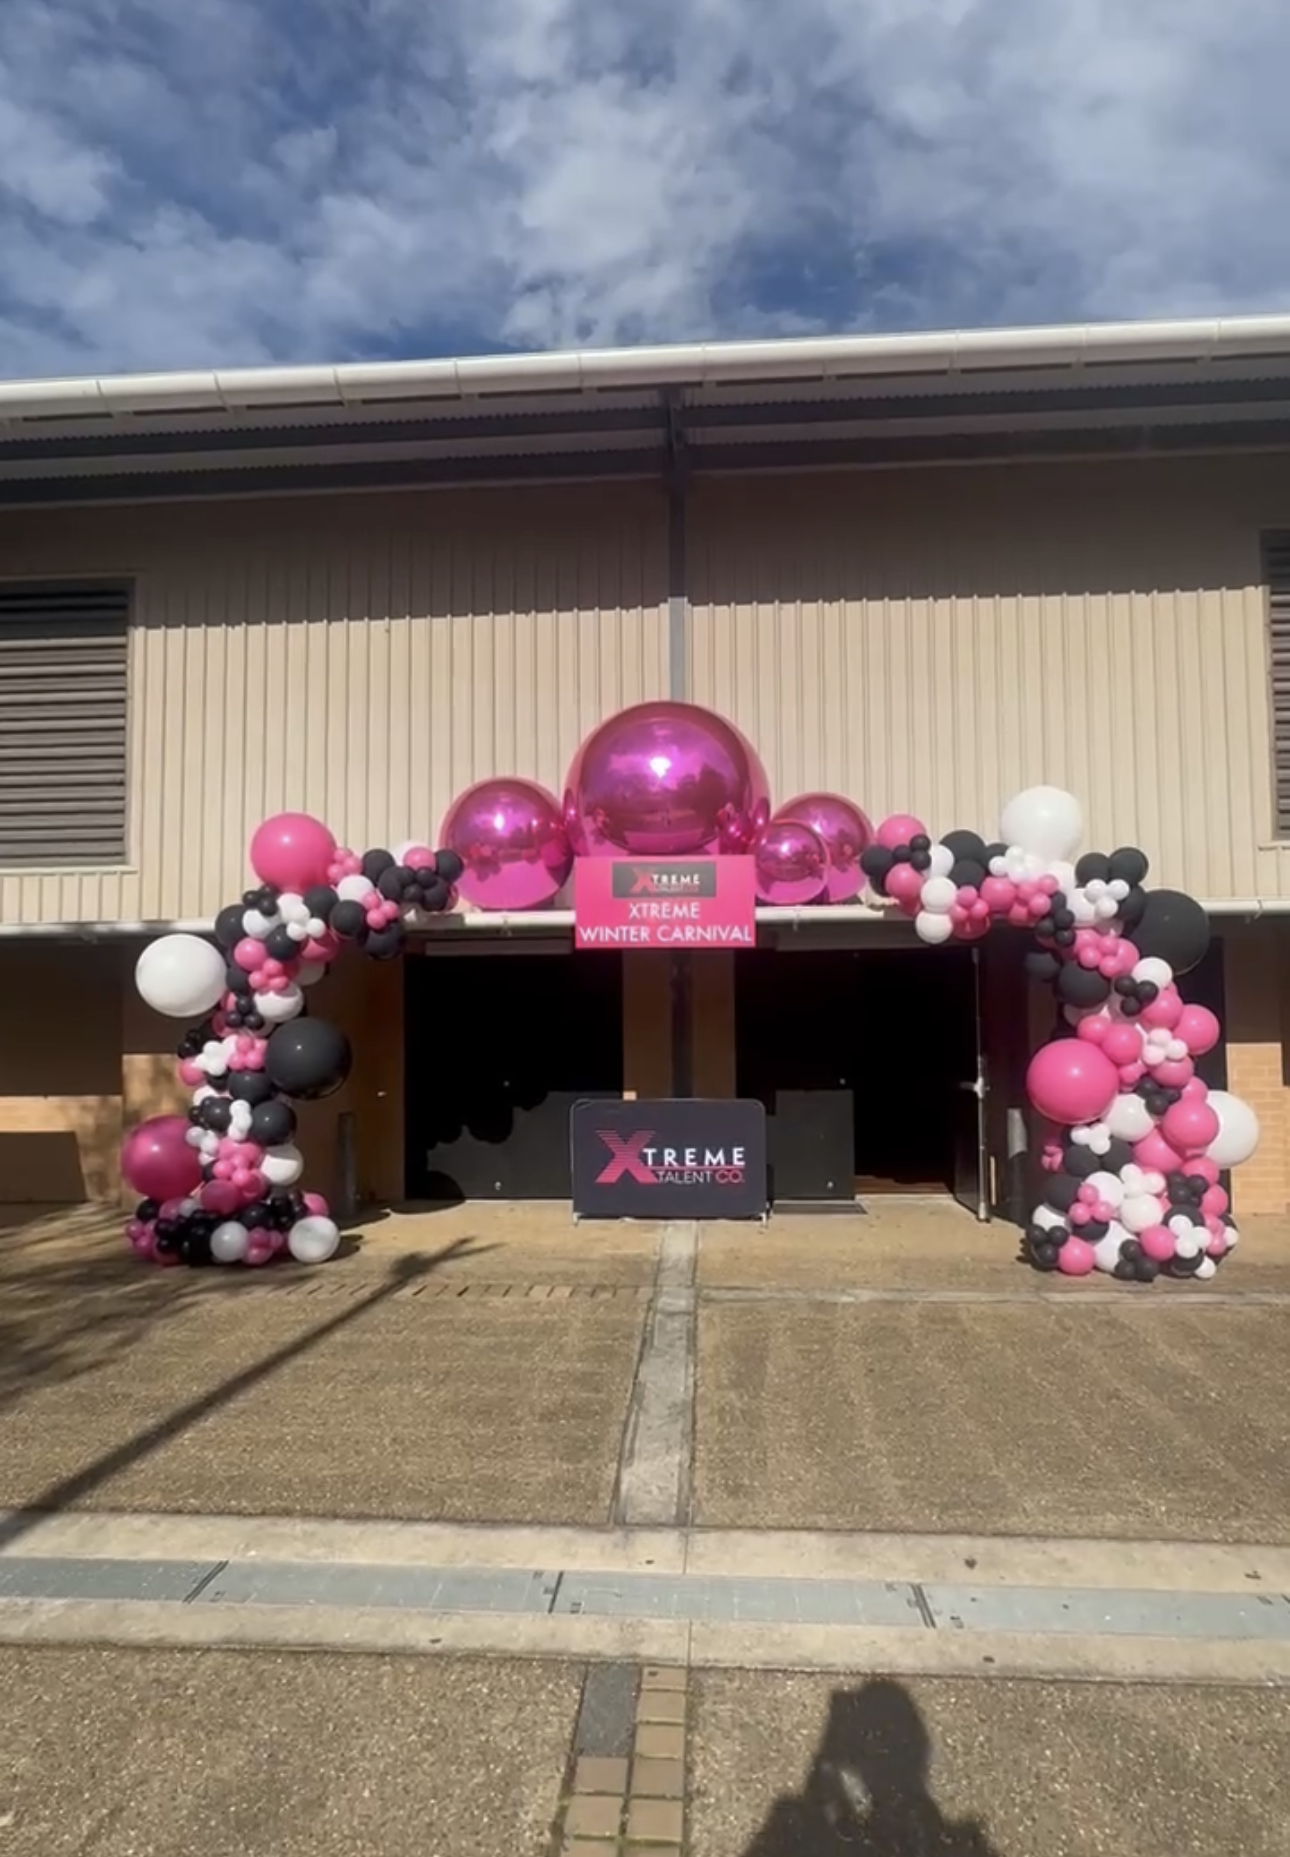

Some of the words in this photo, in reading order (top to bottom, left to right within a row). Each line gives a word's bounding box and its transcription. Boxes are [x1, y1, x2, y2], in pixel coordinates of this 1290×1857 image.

[630, 866, 700, 893] XTREME
[629, 902, 700, 919] XTREME
[579, 925, 650, 942] WINTER
[657, 925, 752, 942] CARNIVAL
[595, 1130, 745, 1184] XTREME
[657, 1171, 712, 1184] TALENT
